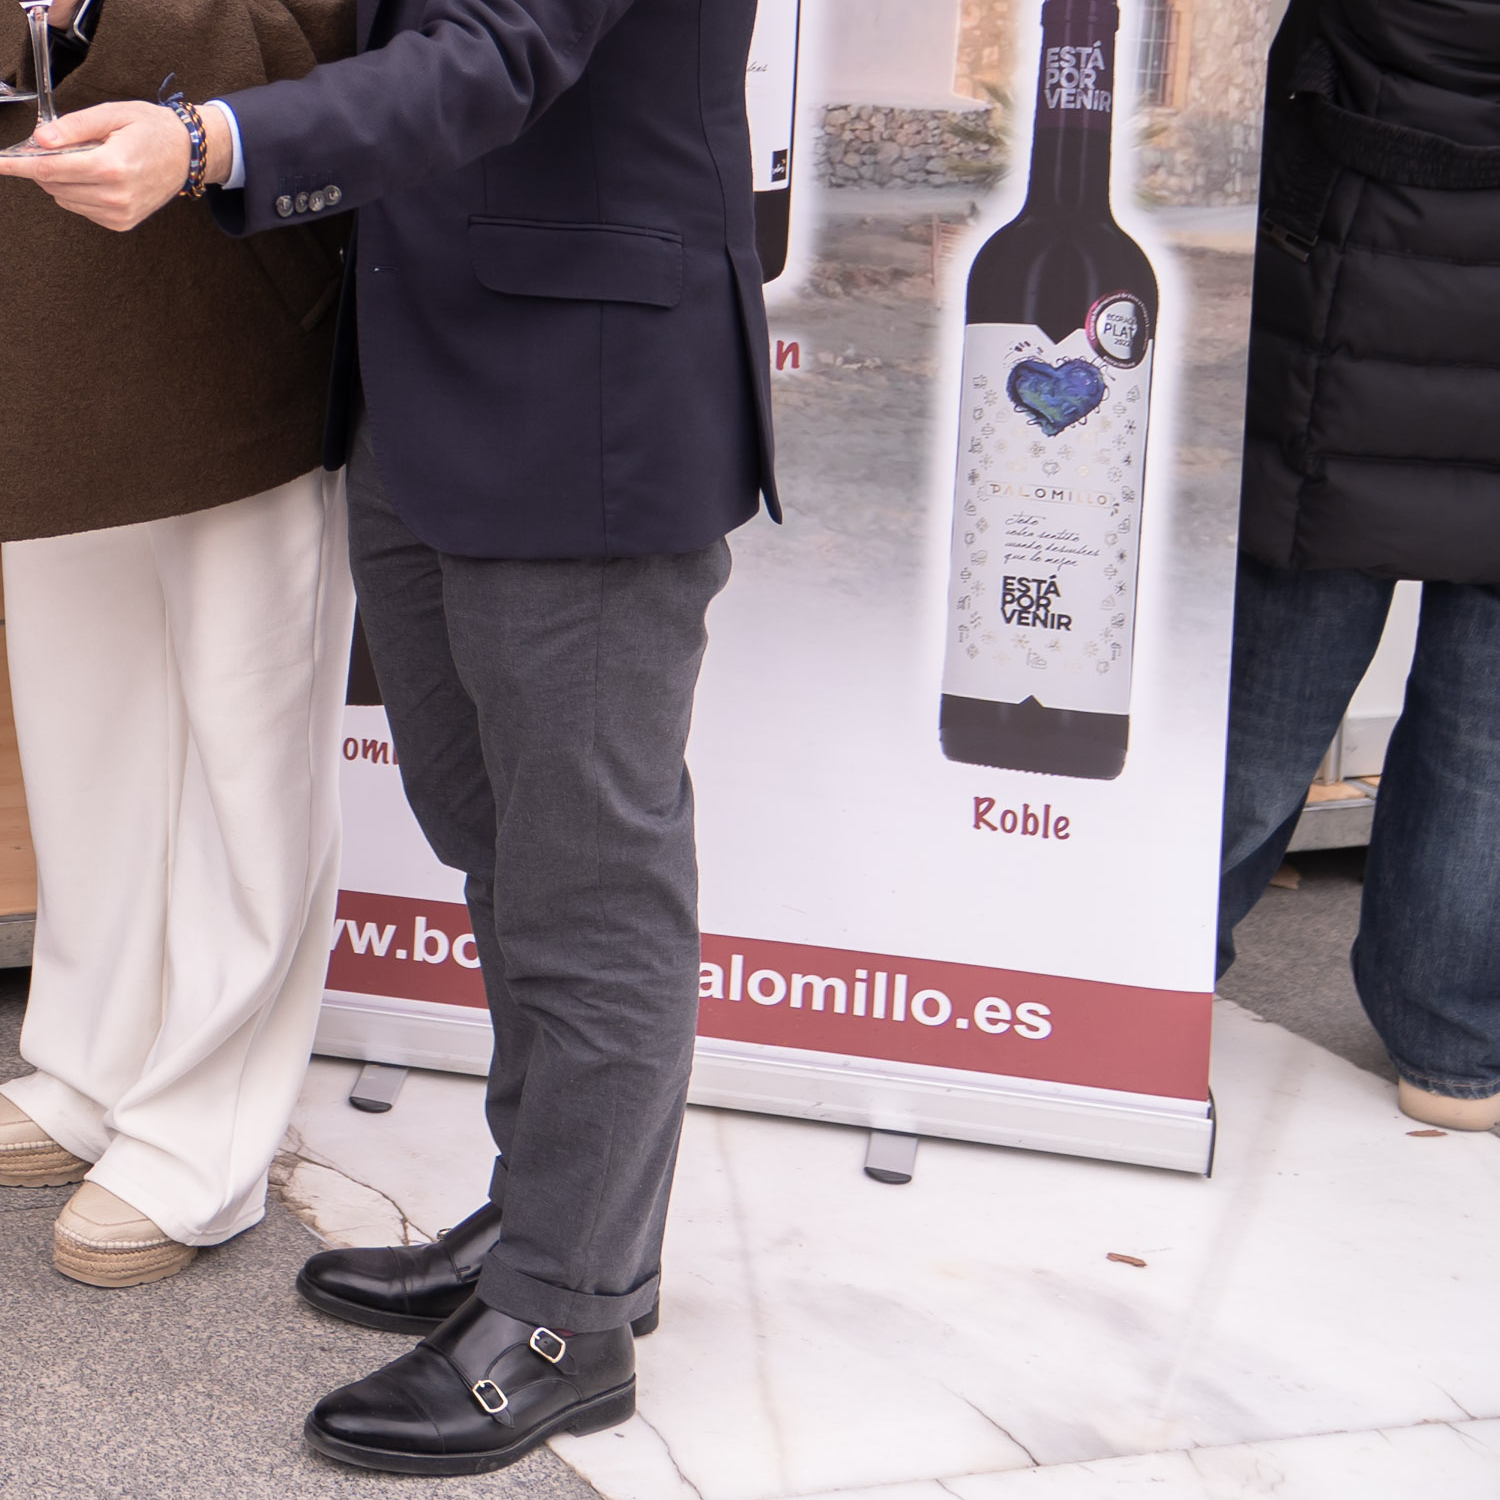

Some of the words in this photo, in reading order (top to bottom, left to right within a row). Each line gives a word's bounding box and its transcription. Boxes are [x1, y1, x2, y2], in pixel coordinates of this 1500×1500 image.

[1046, 40, 1105, 70] ESTÁ
[1045, 67, 1097, 90] POR
[1044, 87, 1112, 113] VENIR
[989, 483, 1108, 505] PALOMILLO
[1003, 574, 1062, 598] ESTÁ
[1002, 591, 1052, 613] POR
[1001, 607, 1073, 632] VENIR
[973, 796, 1070, 840] Roble
